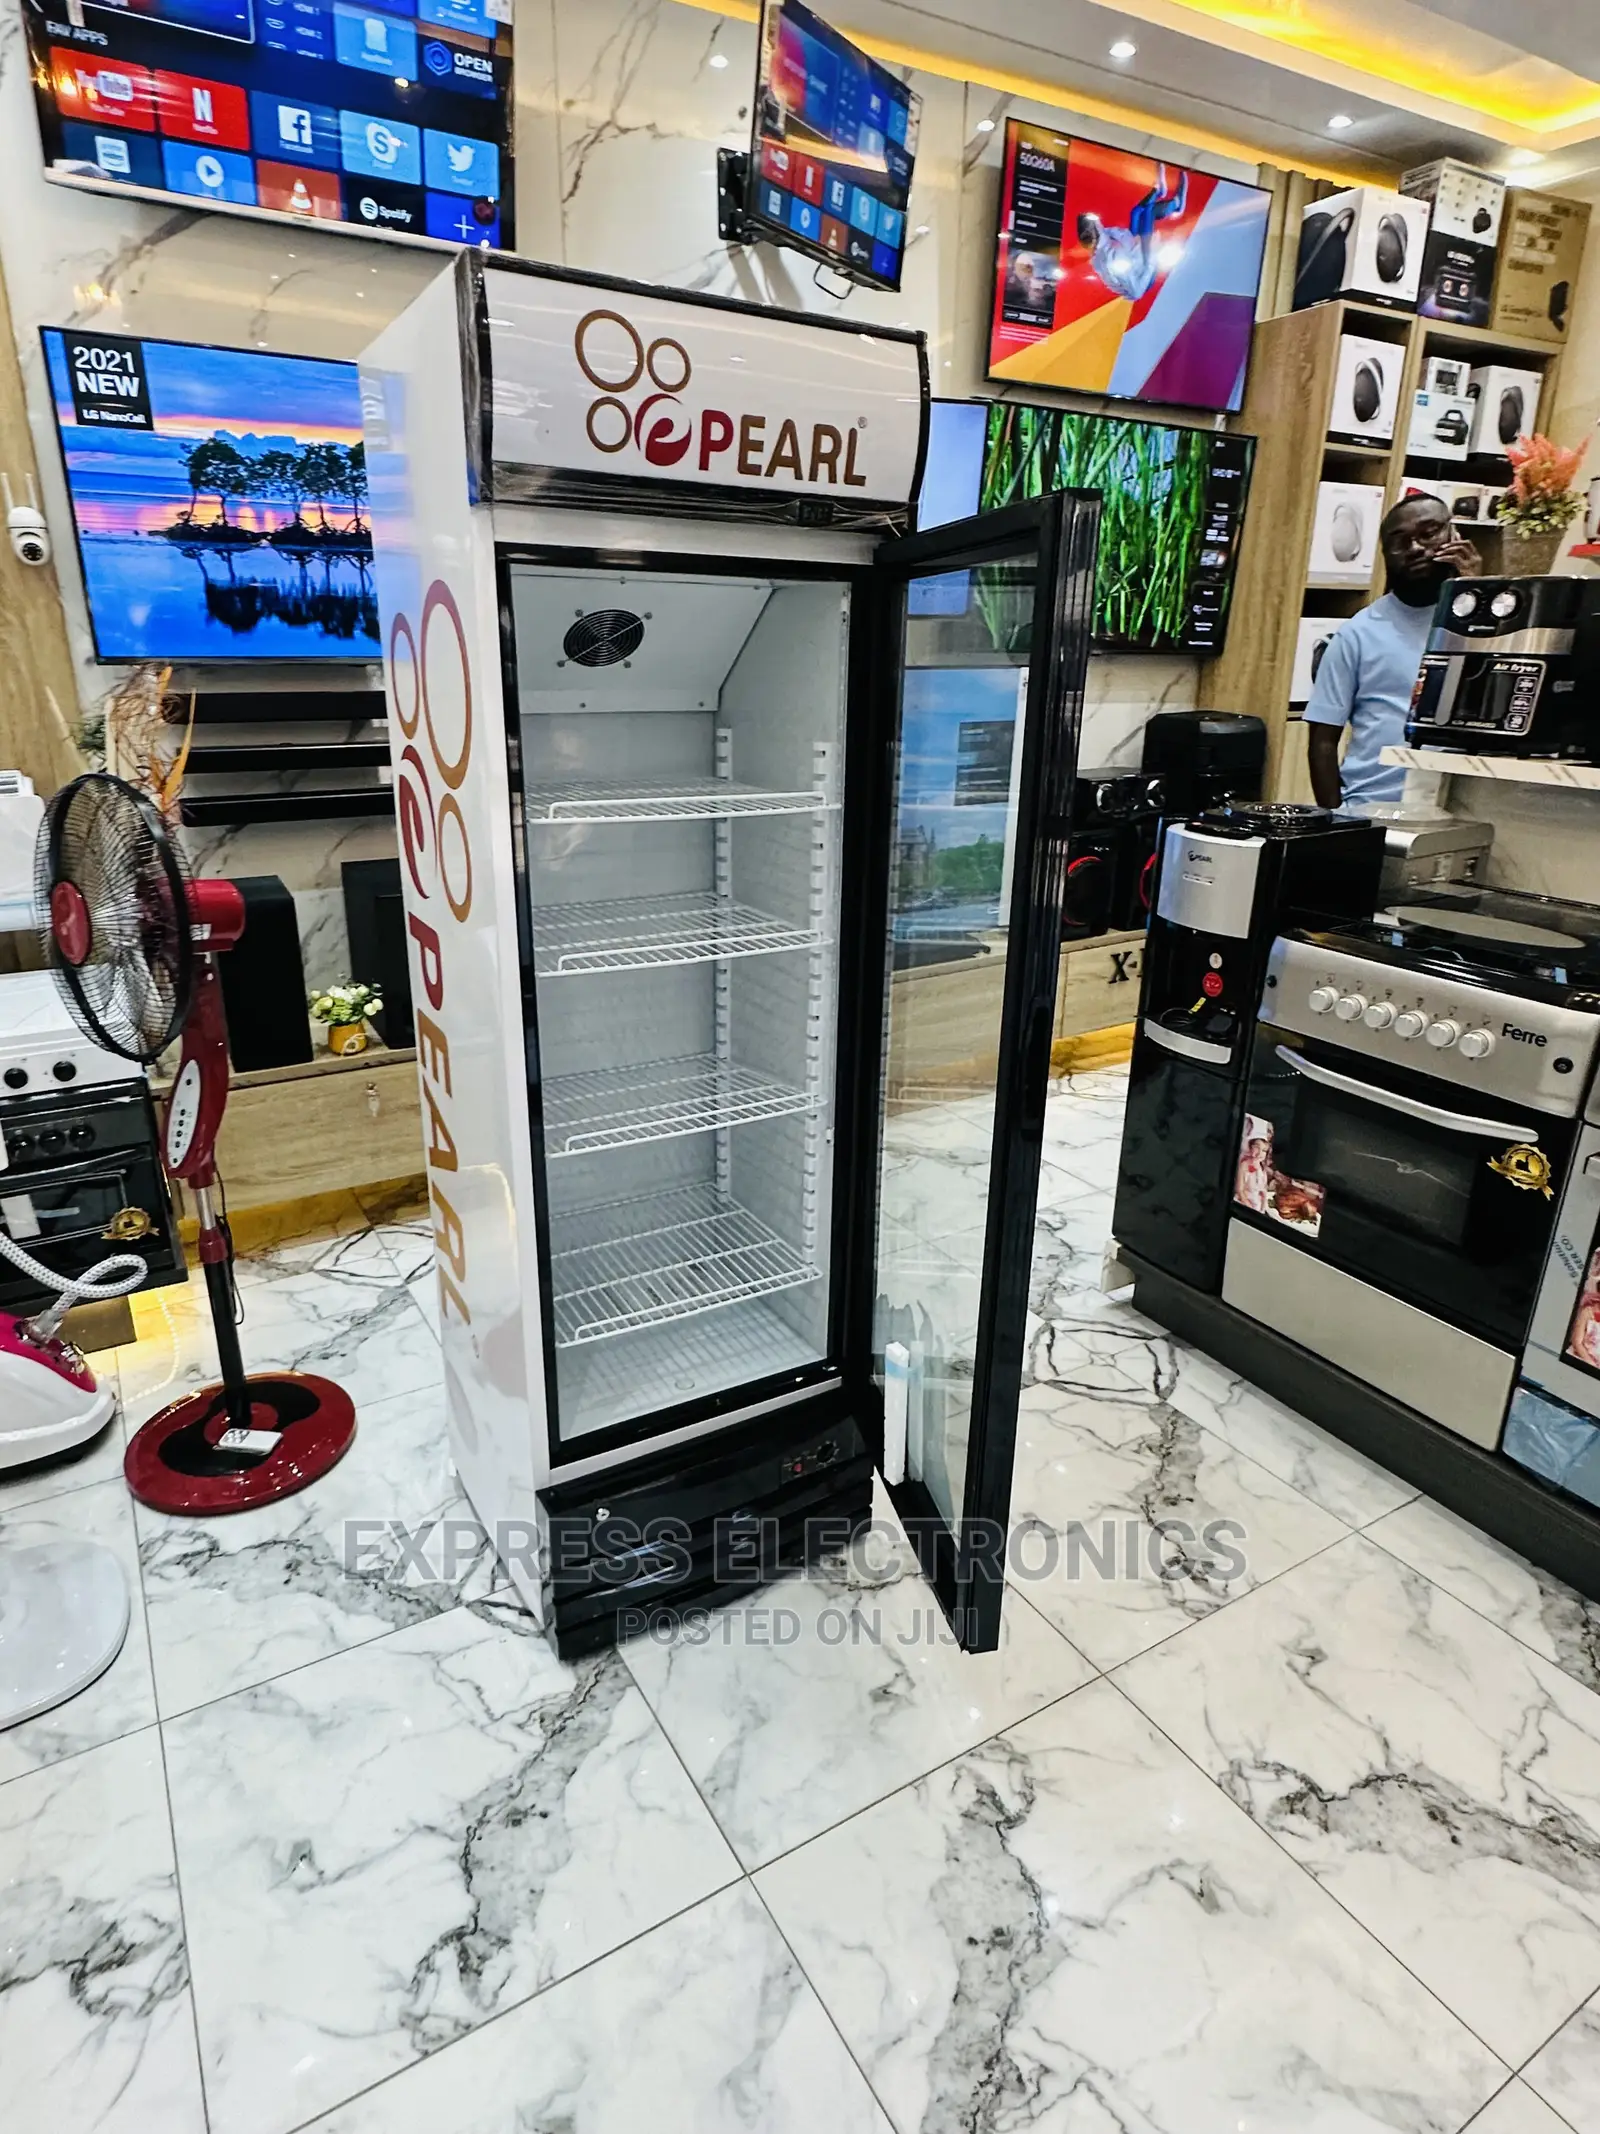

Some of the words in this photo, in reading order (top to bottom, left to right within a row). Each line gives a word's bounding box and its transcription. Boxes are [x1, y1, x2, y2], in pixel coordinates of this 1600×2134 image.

[46, 20, 71, 37] FAV
[73, 27, 108, 45] APPS
[454, 52, 493, 74] OPEN
[379, 205, 413, 224] Spotify
[73, 346, 135, 373] 2021
[76, 371, 140, 397] NEW
[82, 409, 100, 420] LG
[698, 409, 867, 487] PEARL
[1493, 662, 1509, 671] Air
[1510, 662, 1540, 674] fryer
[1501, 1022, 1548, 1048] Ferre
[408, 911, 471, 1326] PEARL
